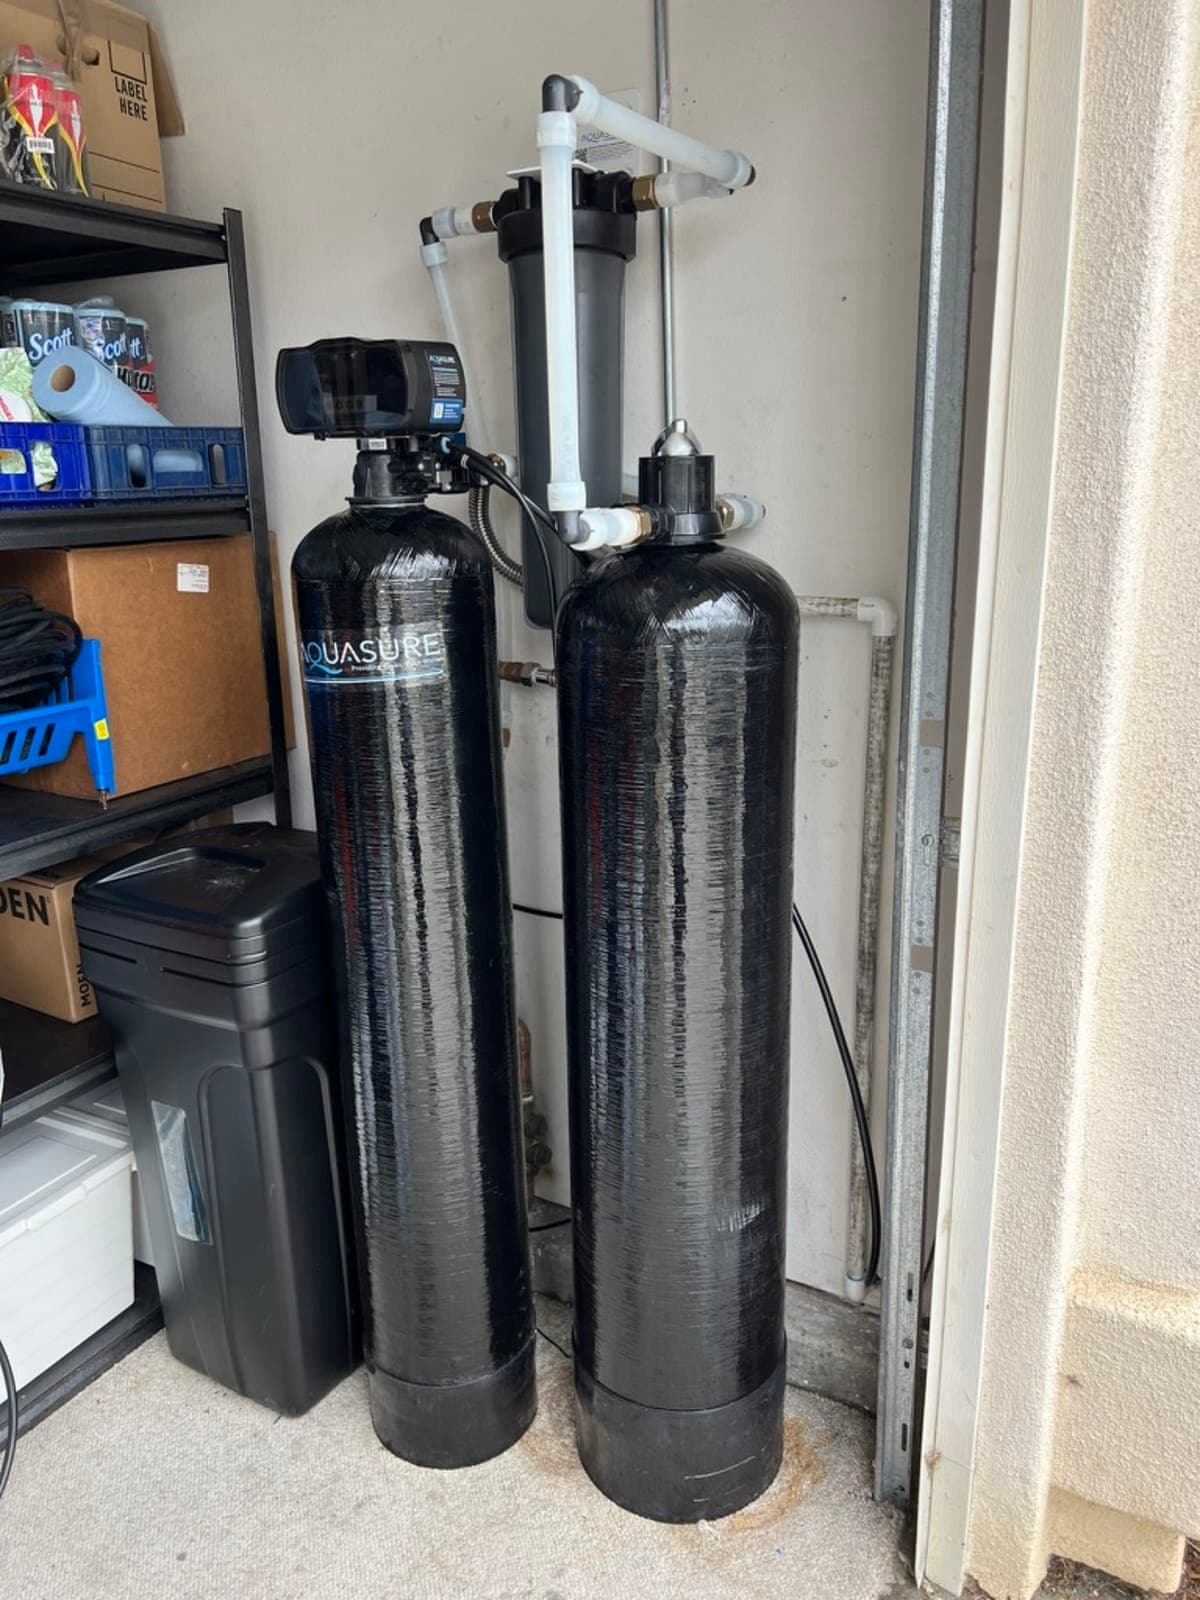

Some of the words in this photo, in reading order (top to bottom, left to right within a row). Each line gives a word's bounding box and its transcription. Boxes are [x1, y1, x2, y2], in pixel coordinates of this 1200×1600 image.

[115, 77, 148, 103] LABEL
[119, 98, 148, 121] HERE
[29, 327, 72, 360] Scott
